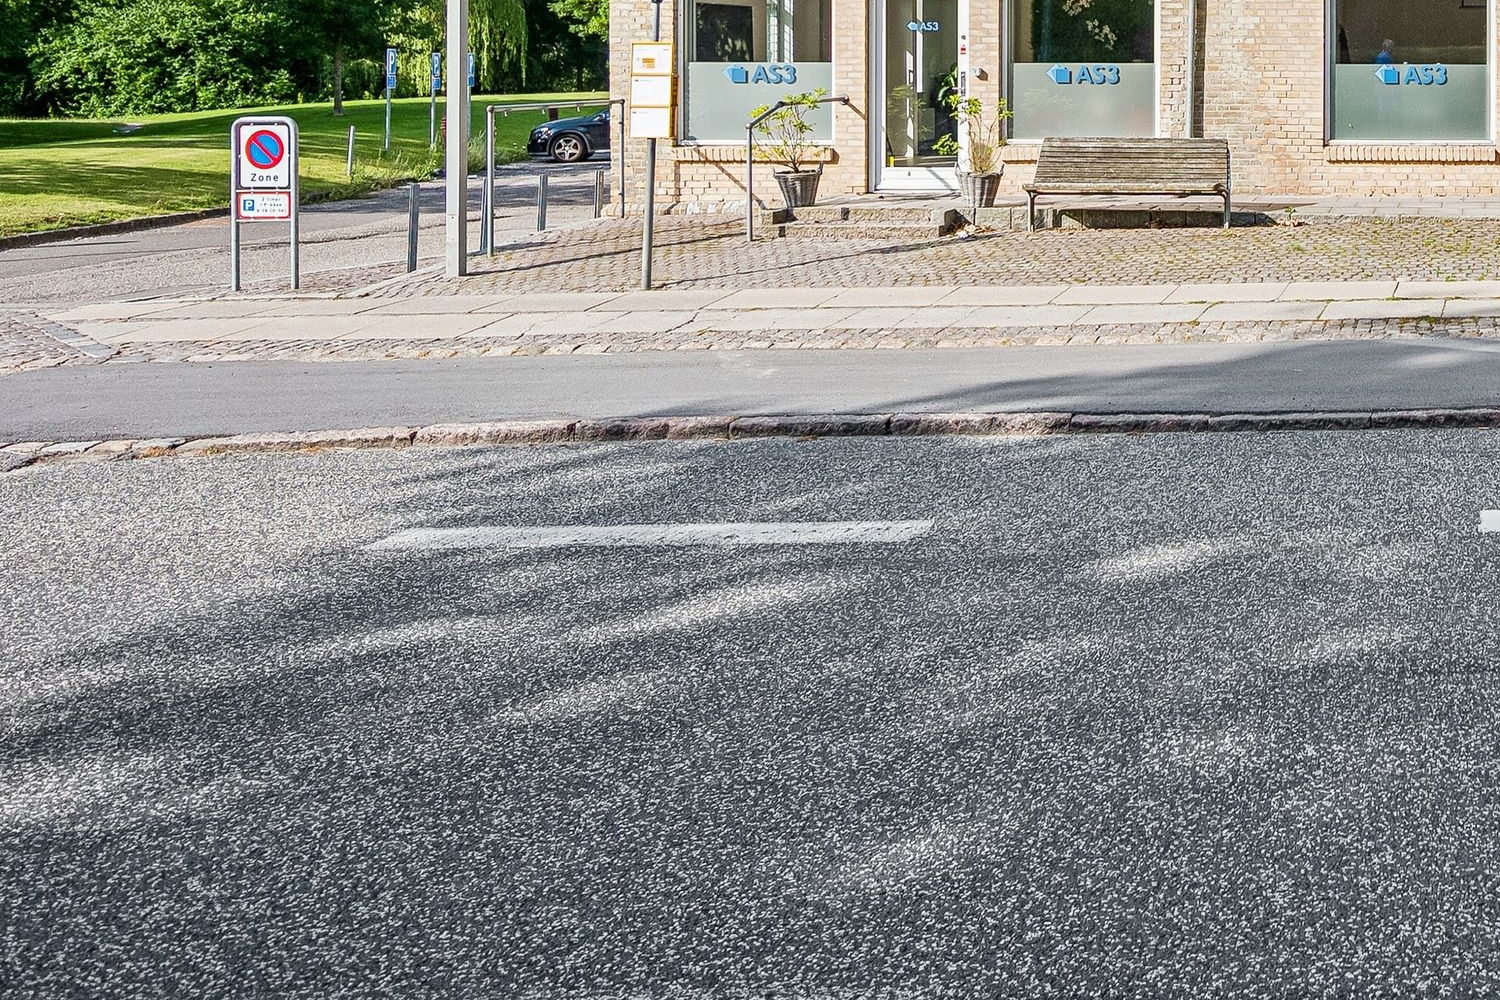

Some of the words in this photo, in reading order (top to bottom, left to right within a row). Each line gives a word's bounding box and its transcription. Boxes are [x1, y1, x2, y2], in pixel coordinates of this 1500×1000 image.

[920, 21, 939, 31] AS3
[389, 52, 395, 73] P
[752, 64, 797, 85] AS3
[1075, 65, 1120, 85] AS3
[1404, 65, 1448, 85] AS3
[250, 173, 279, 182] Zone
[245, 200, 254, 211] P
